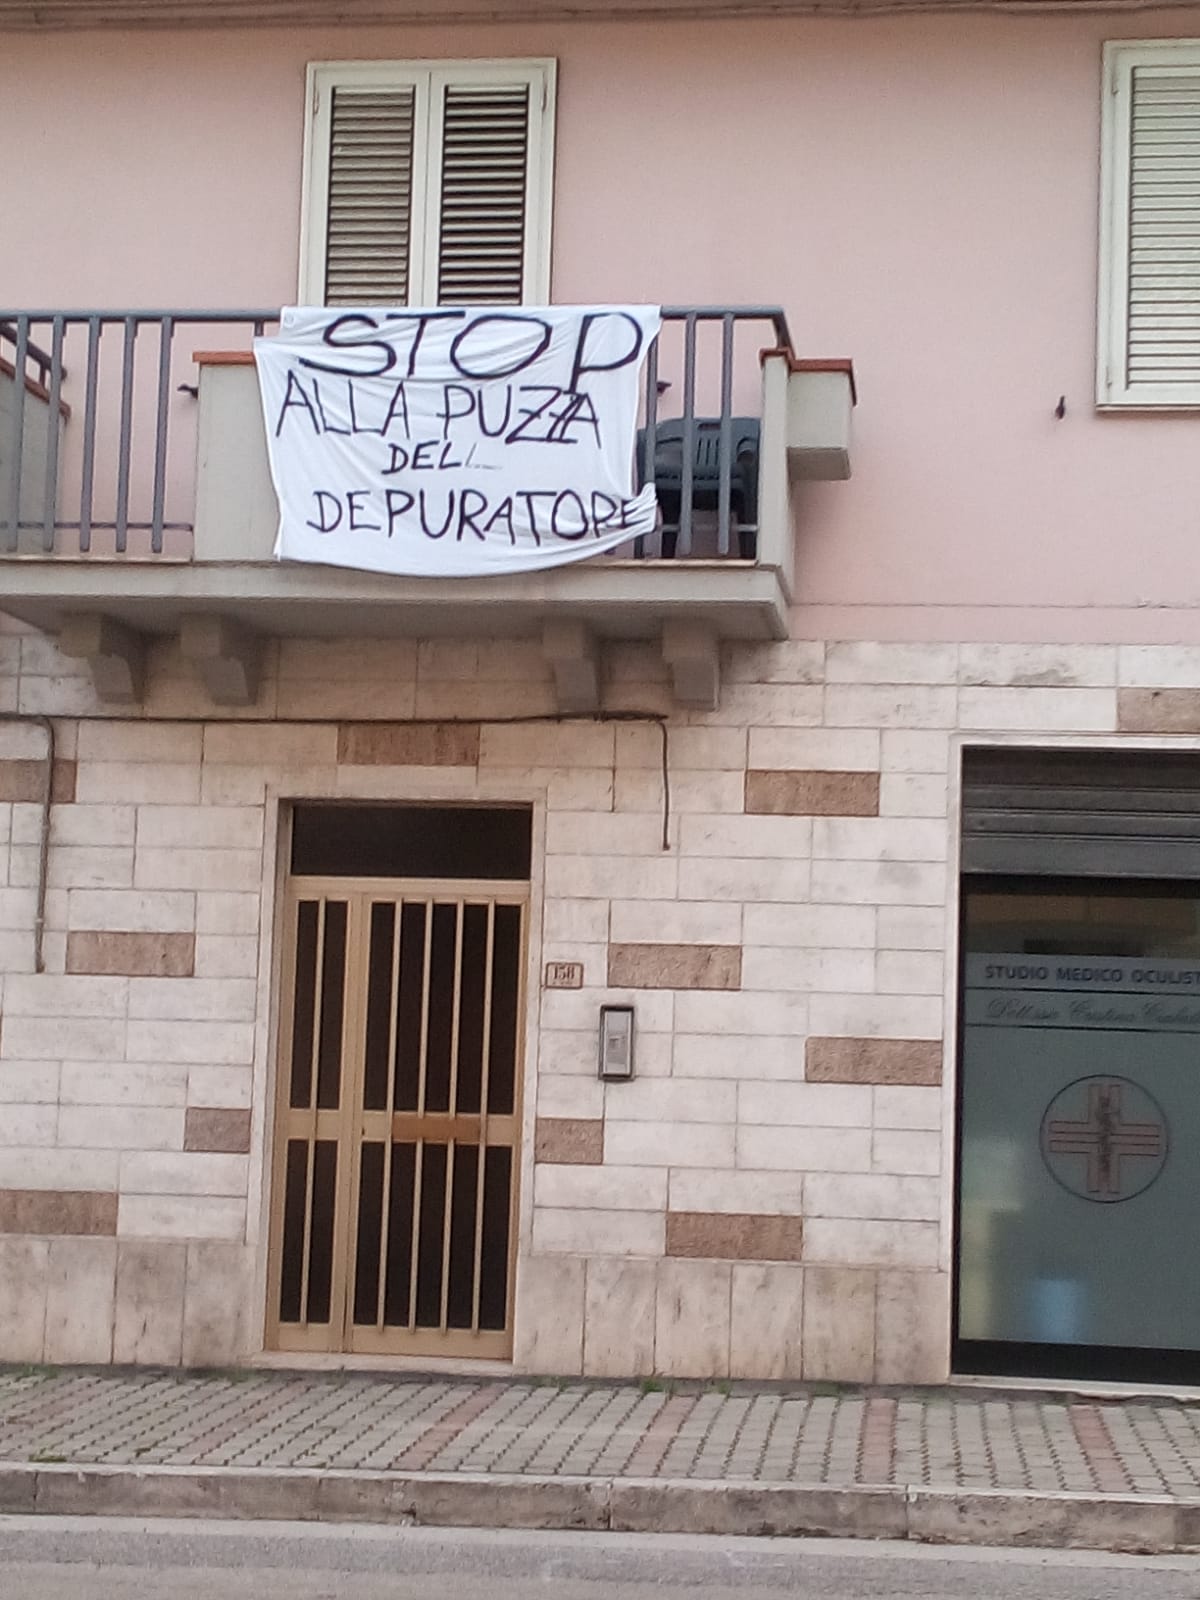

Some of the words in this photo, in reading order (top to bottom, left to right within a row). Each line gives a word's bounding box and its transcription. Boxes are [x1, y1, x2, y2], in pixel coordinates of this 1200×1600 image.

[299, 311, 643, 393] STOP
[276, 370, 410, 440] ALLA
[436, 384, 602, 449] PUZZA
[306, 488, 650, 547] DEPURATORE
[985, 965, 1049, 981] STUDIO
[1055, 967, 1123, 983] MEDICO
